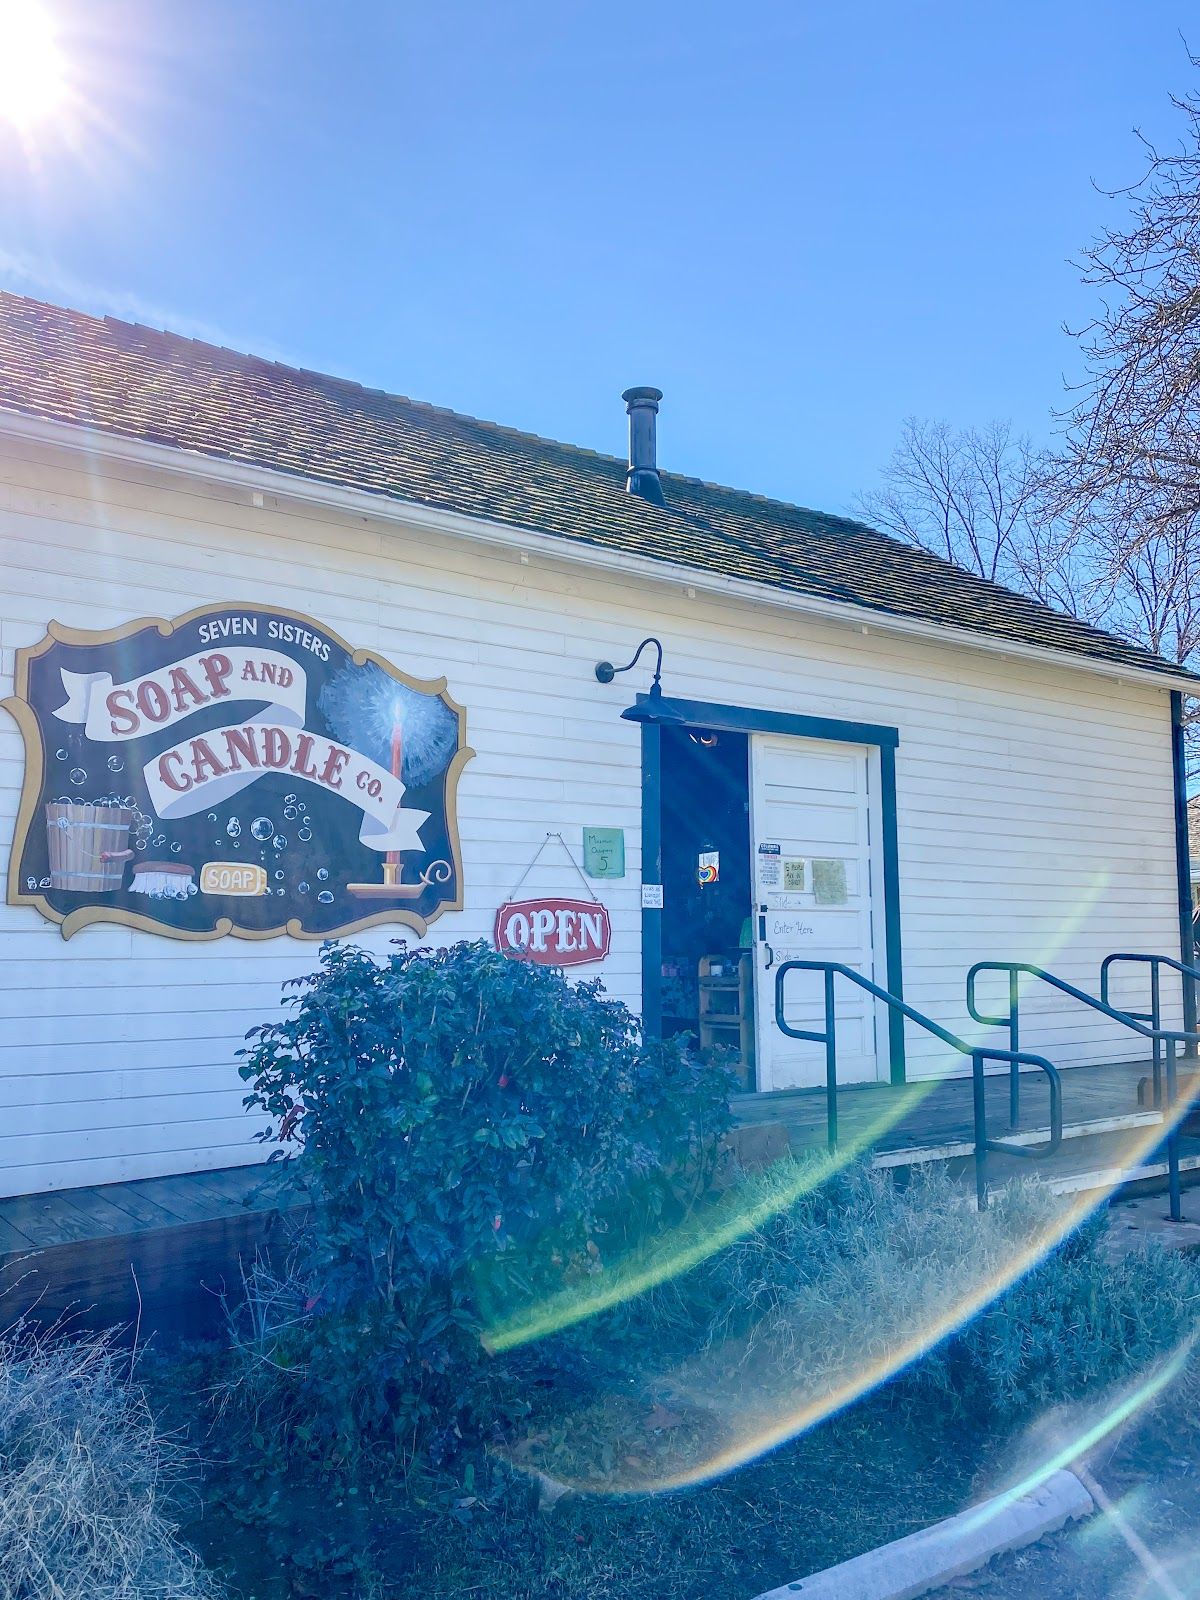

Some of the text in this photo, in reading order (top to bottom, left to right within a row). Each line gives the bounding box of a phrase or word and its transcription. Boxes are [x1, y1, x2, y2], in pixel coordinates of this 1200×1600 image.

[198, 618, 331, 662] SEVEN SISTERS
[106, 652, 294, 736] SOAP AND
[158, 726, 385, 803] CANDLE CO.
[205, 868, 255, 889] SOAP
[599, 856, 609, 871] 5
[504, 909, 603, 952] OPEN
[774, 920, 814, 936] Enter Here
